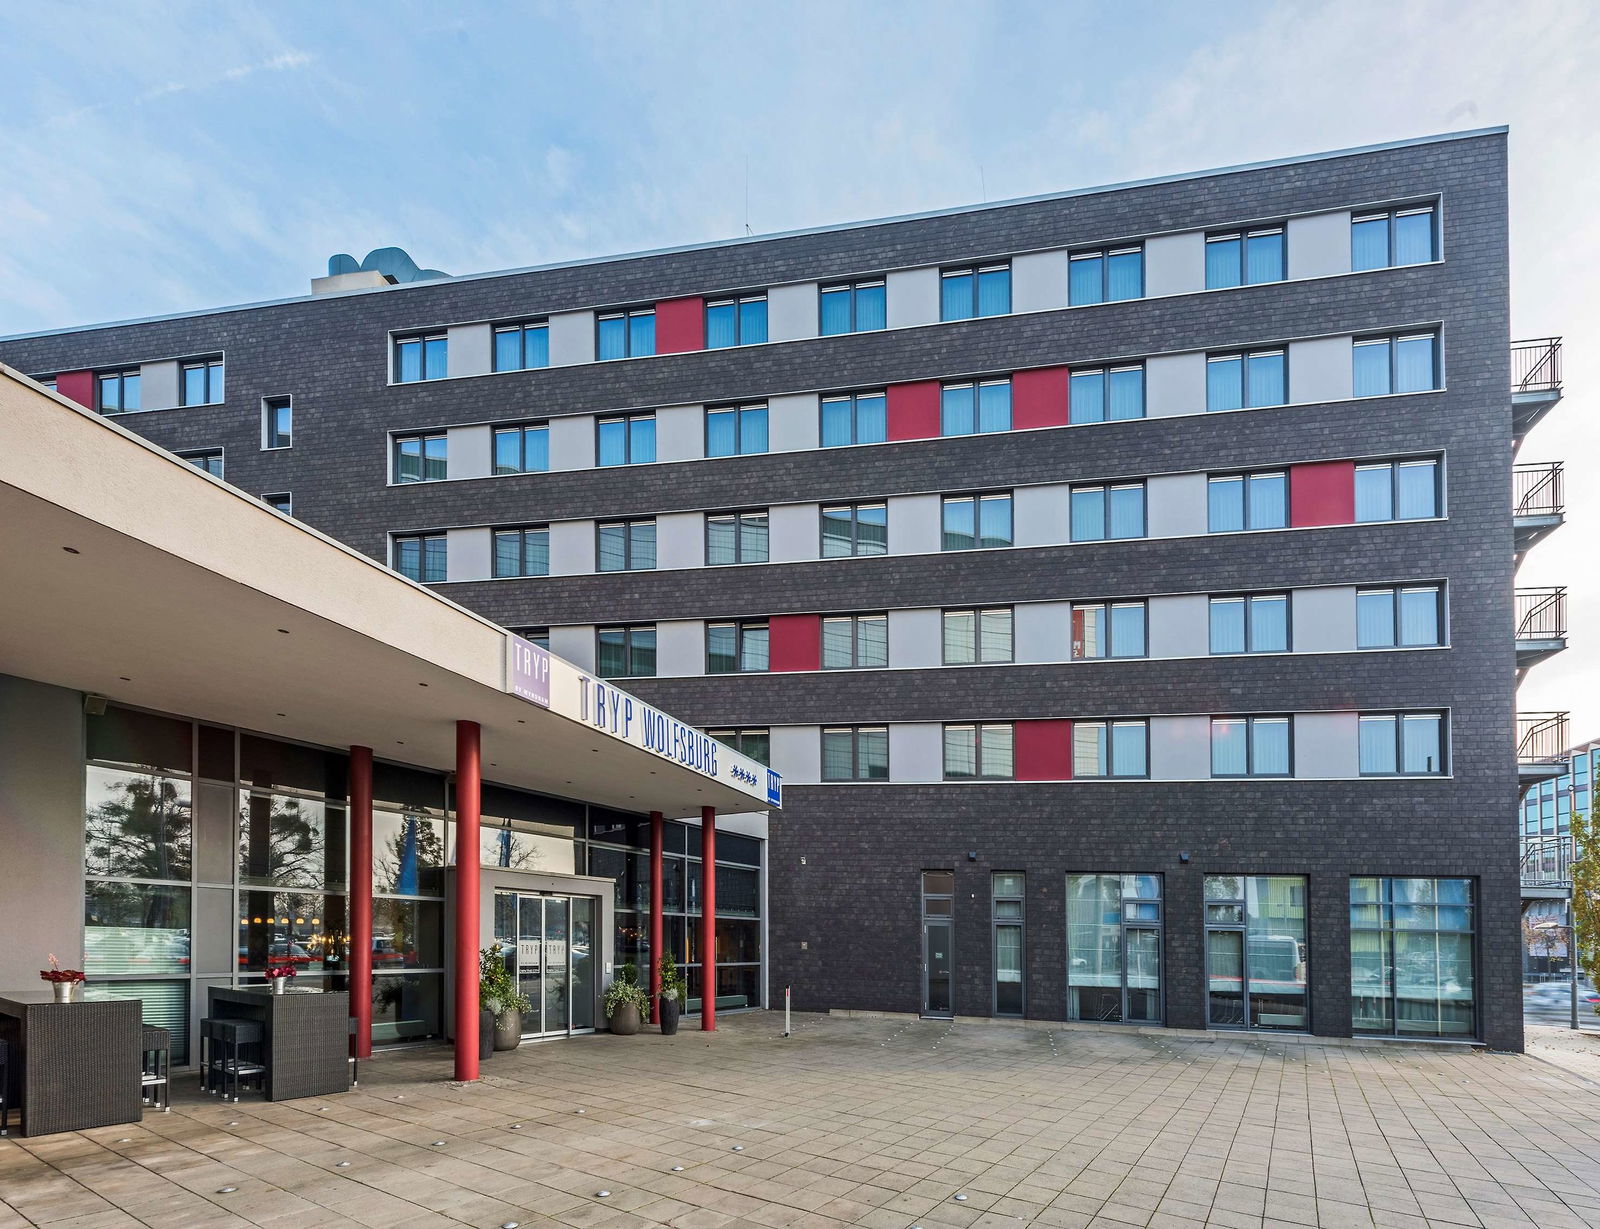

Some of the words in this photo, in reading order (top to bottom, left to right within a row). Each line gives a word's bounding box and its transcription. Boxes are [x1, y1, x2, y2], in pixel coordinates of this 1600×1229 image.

[515, 643, 548, 683] TRYP
[578, 676, 632, 738] TRYP
[642, 707, 718, 777] WOLFSBURG
